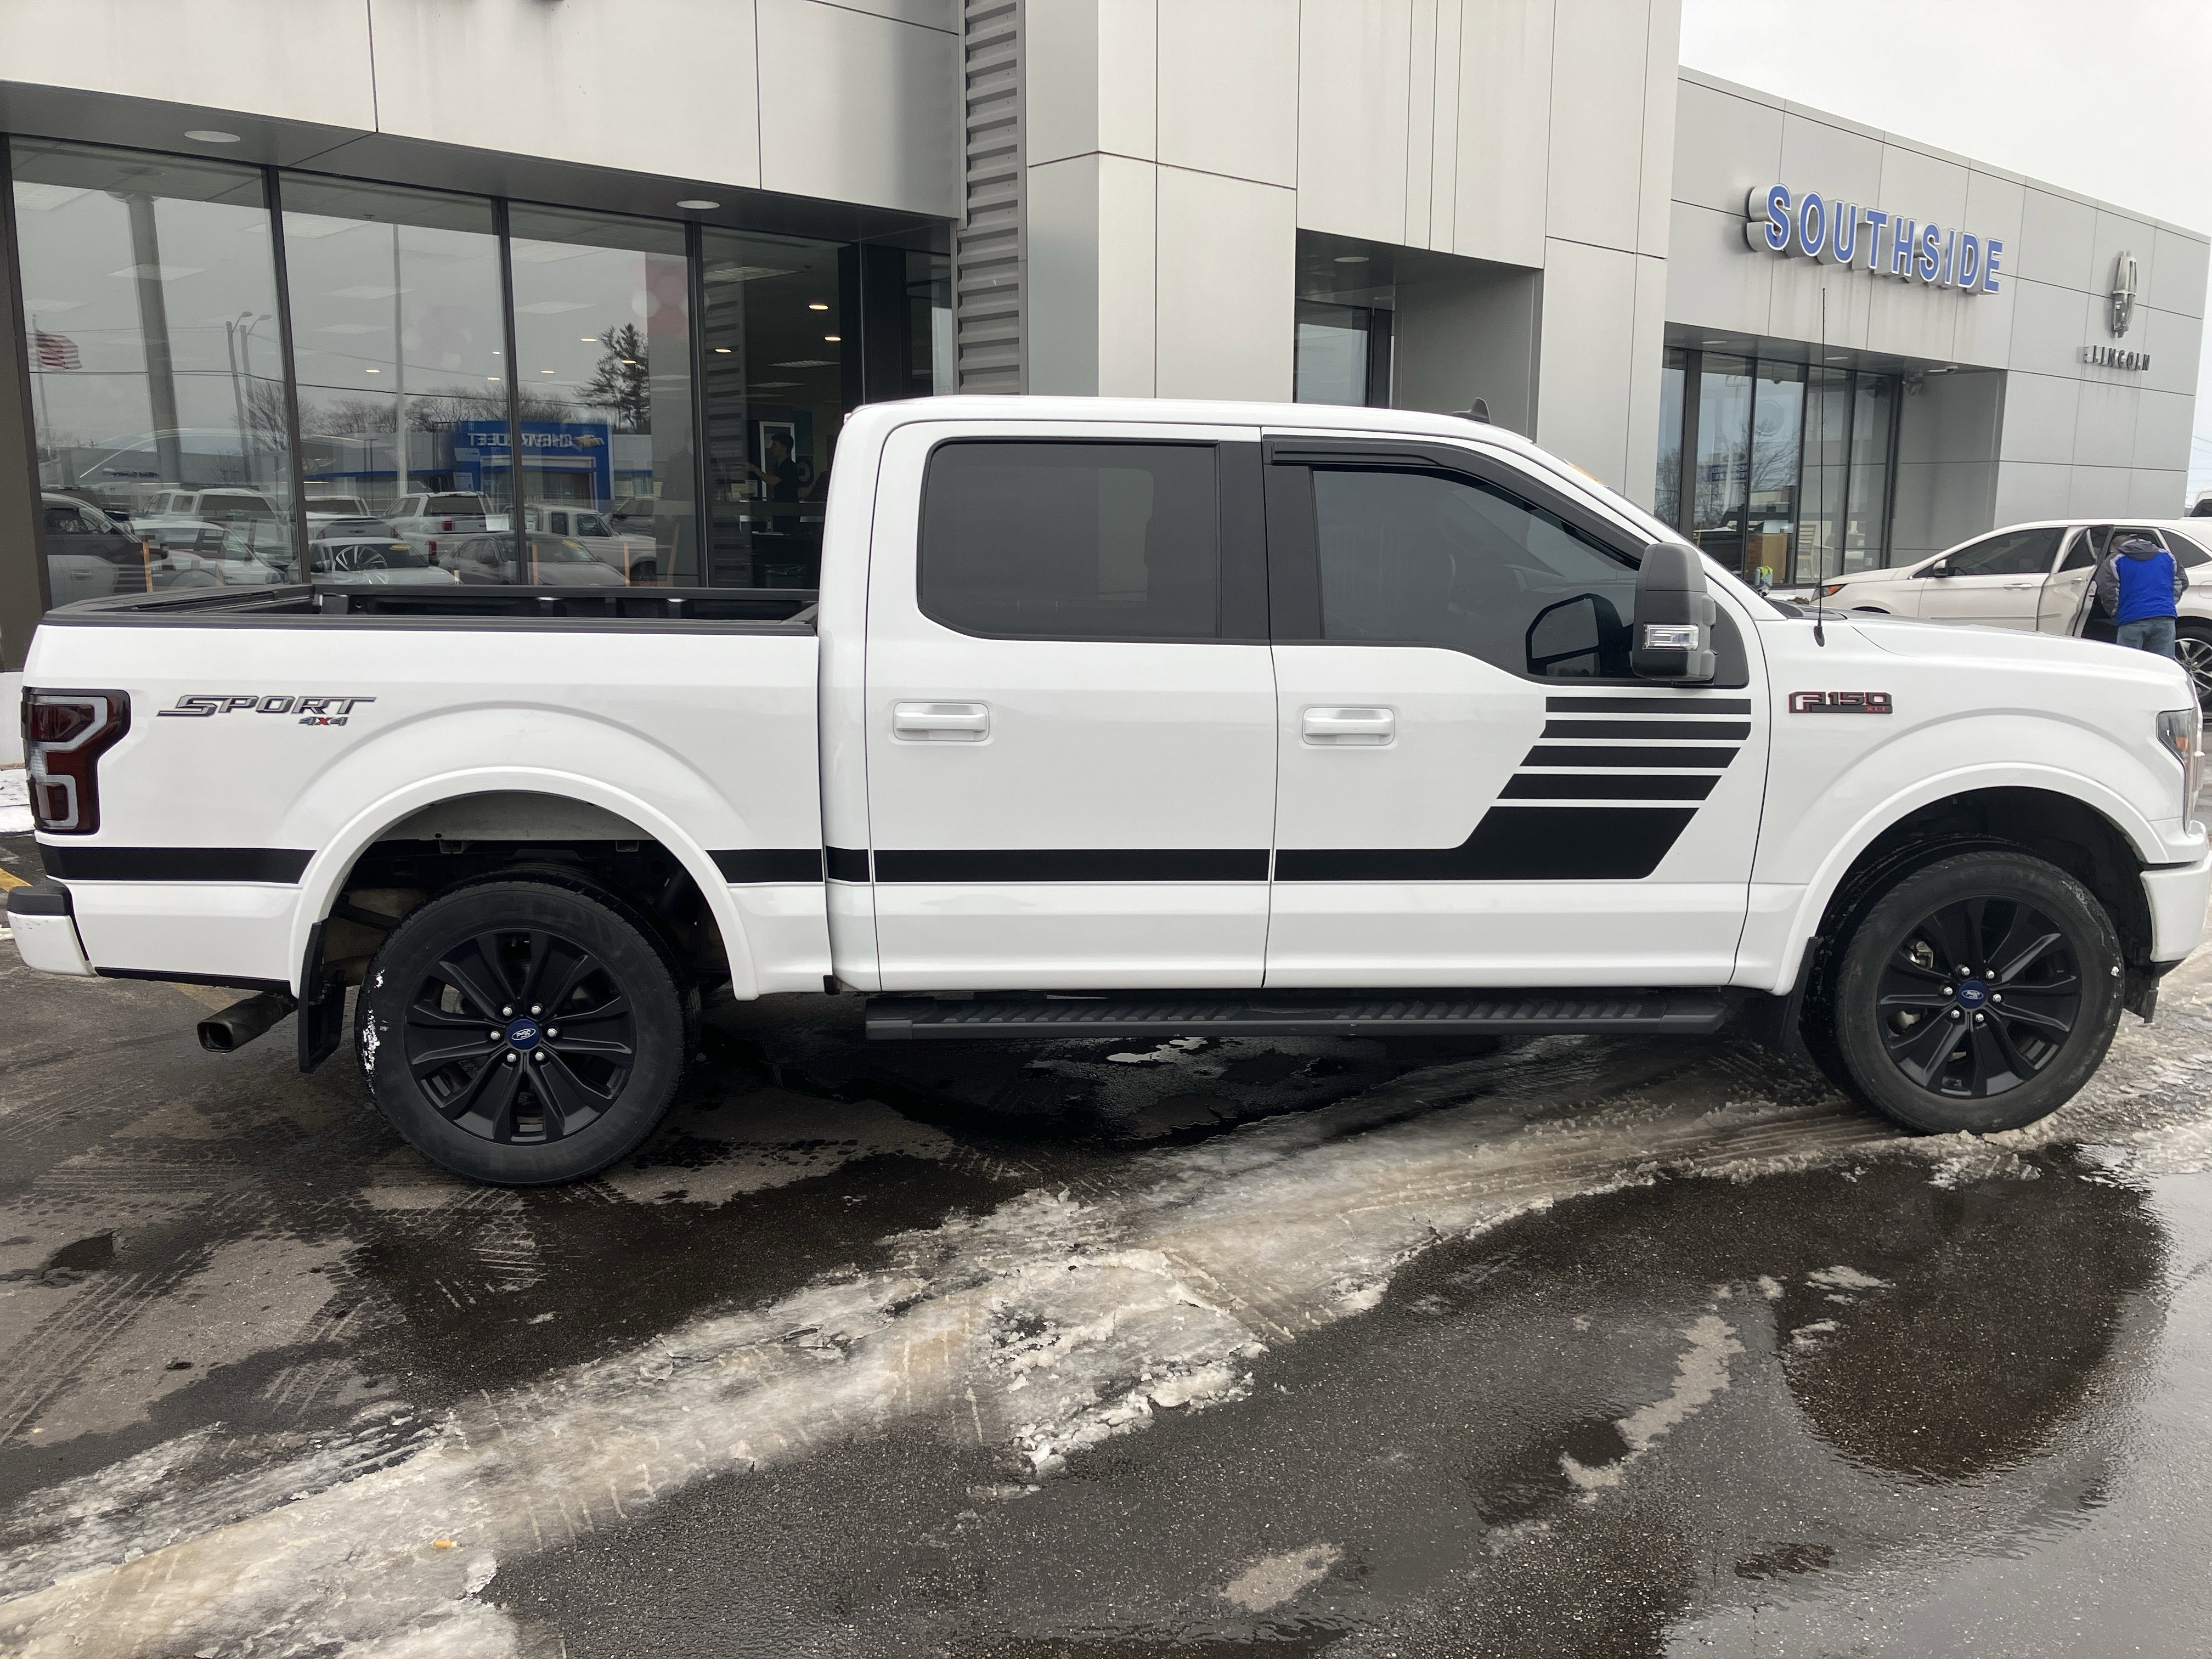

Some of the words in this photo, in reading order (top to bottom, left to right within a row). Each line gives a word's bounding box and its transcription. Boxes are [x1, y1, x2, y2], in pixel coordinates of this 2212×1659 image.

[1764, 183, 2004, 294] SOUTHSIDE
[2092, 345, 2151, 371] LINCOLN
[157, 695, 376, 716] SPORT
